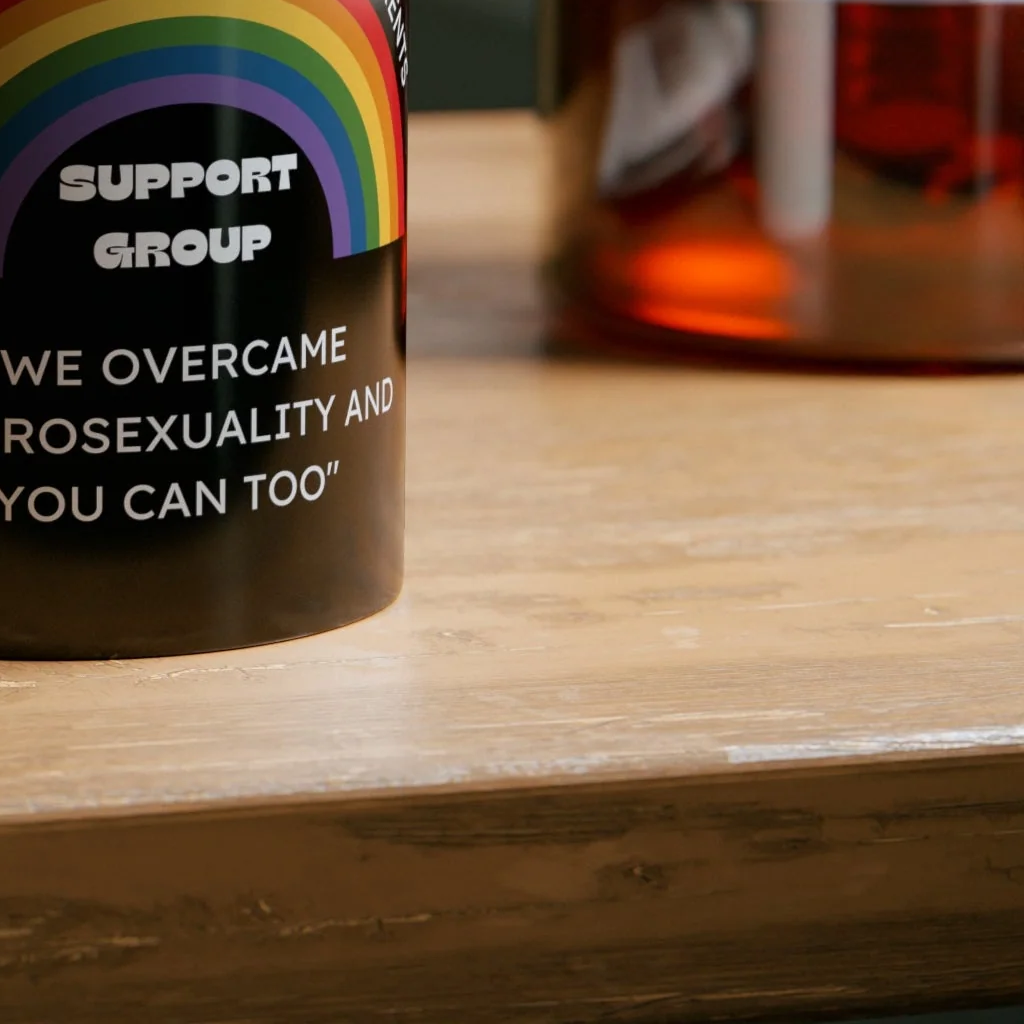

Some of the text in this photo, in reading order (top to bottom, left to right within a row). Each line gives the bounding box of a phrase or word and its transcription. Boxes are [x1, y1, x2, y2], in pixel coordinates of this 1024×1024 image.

[59, 153, 299, 202] SUPPORT
[93, 224, 273, 270] GROUP
[101, 326, 347, 386] OVERCAME
[344, 377, 394, 426] AND
[123, 478, 227, 519] CAN
